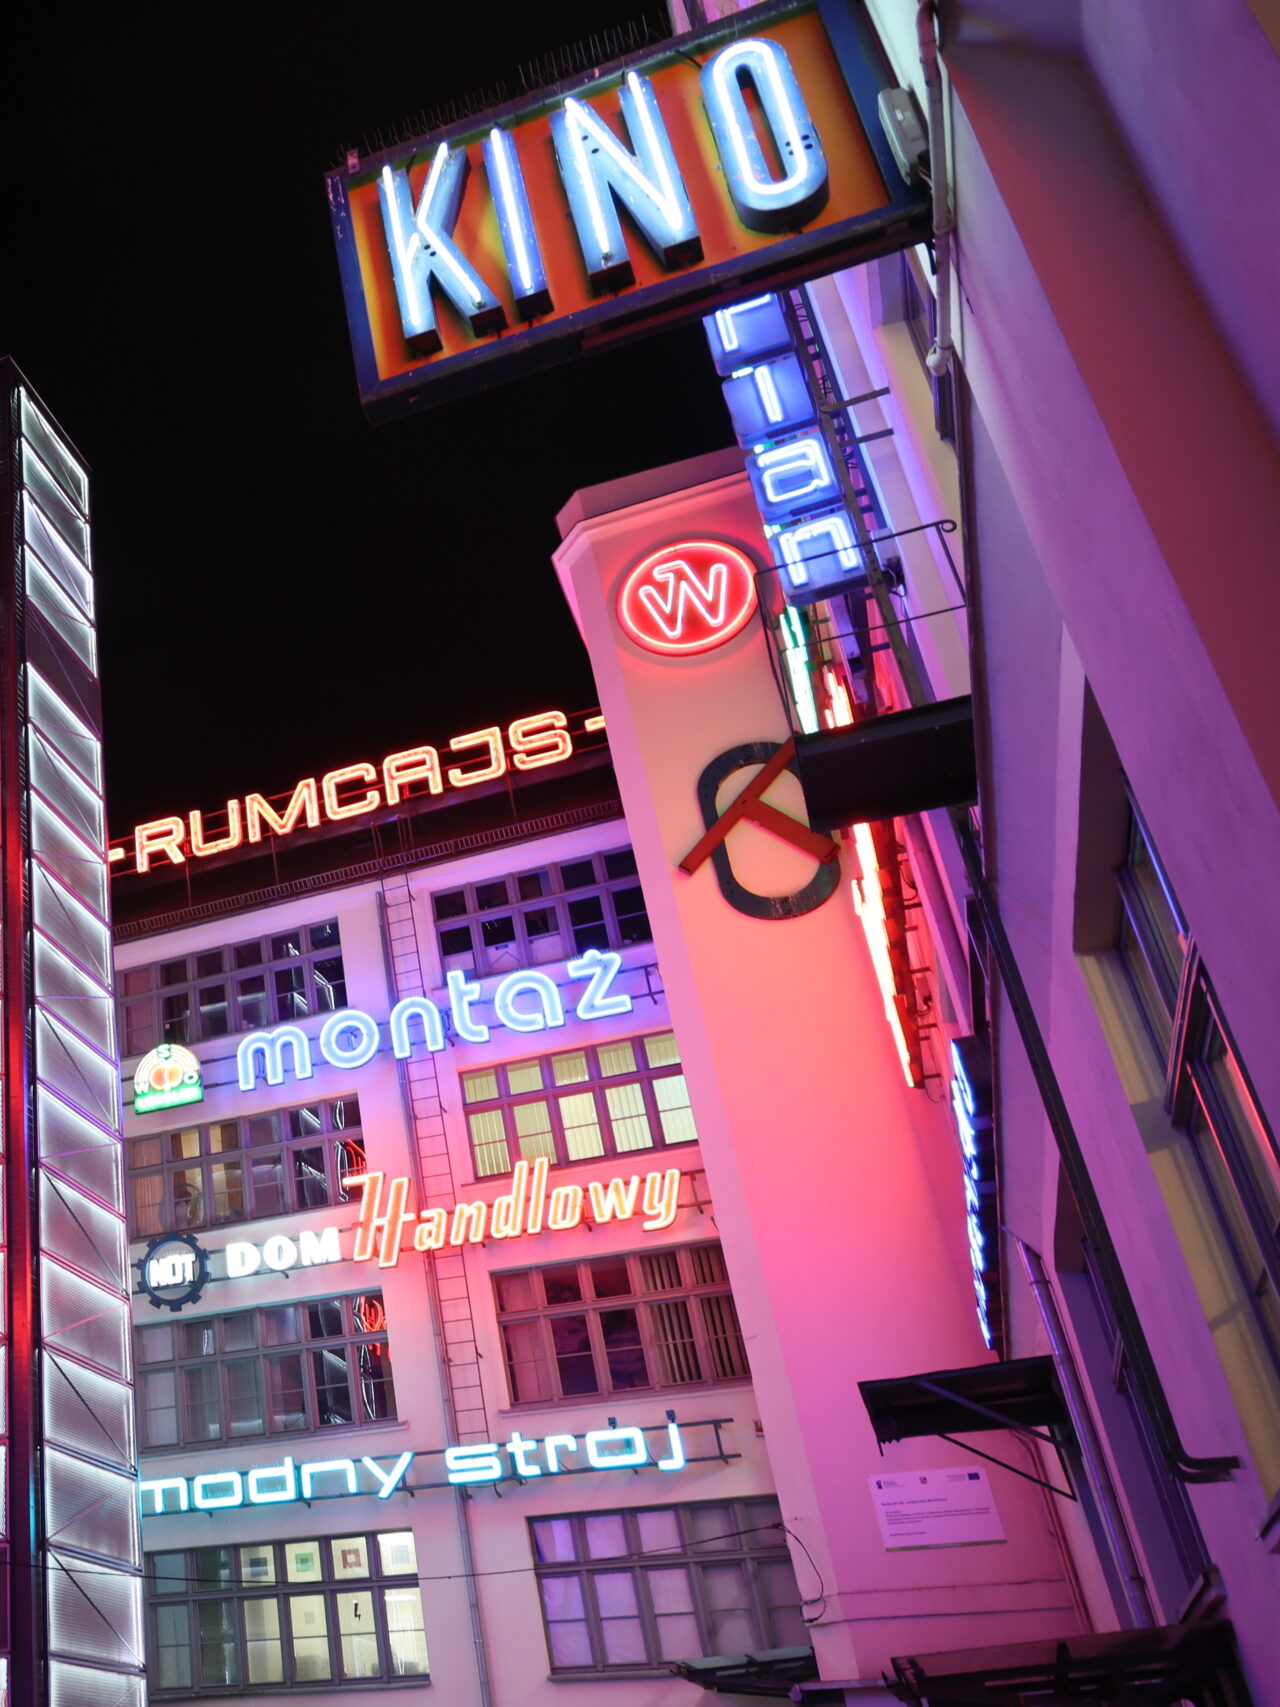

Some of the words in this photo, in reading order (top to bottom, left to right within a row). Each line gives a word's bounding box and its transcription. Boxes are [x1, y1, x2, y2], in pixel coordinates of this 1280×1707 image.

[377, 36, 830, 355] KINO
[225, 1226, 342, 1279] DOM
[341, 1156, 682, 1270] Handlowy
[138, 1450, 416, 1514] modny
